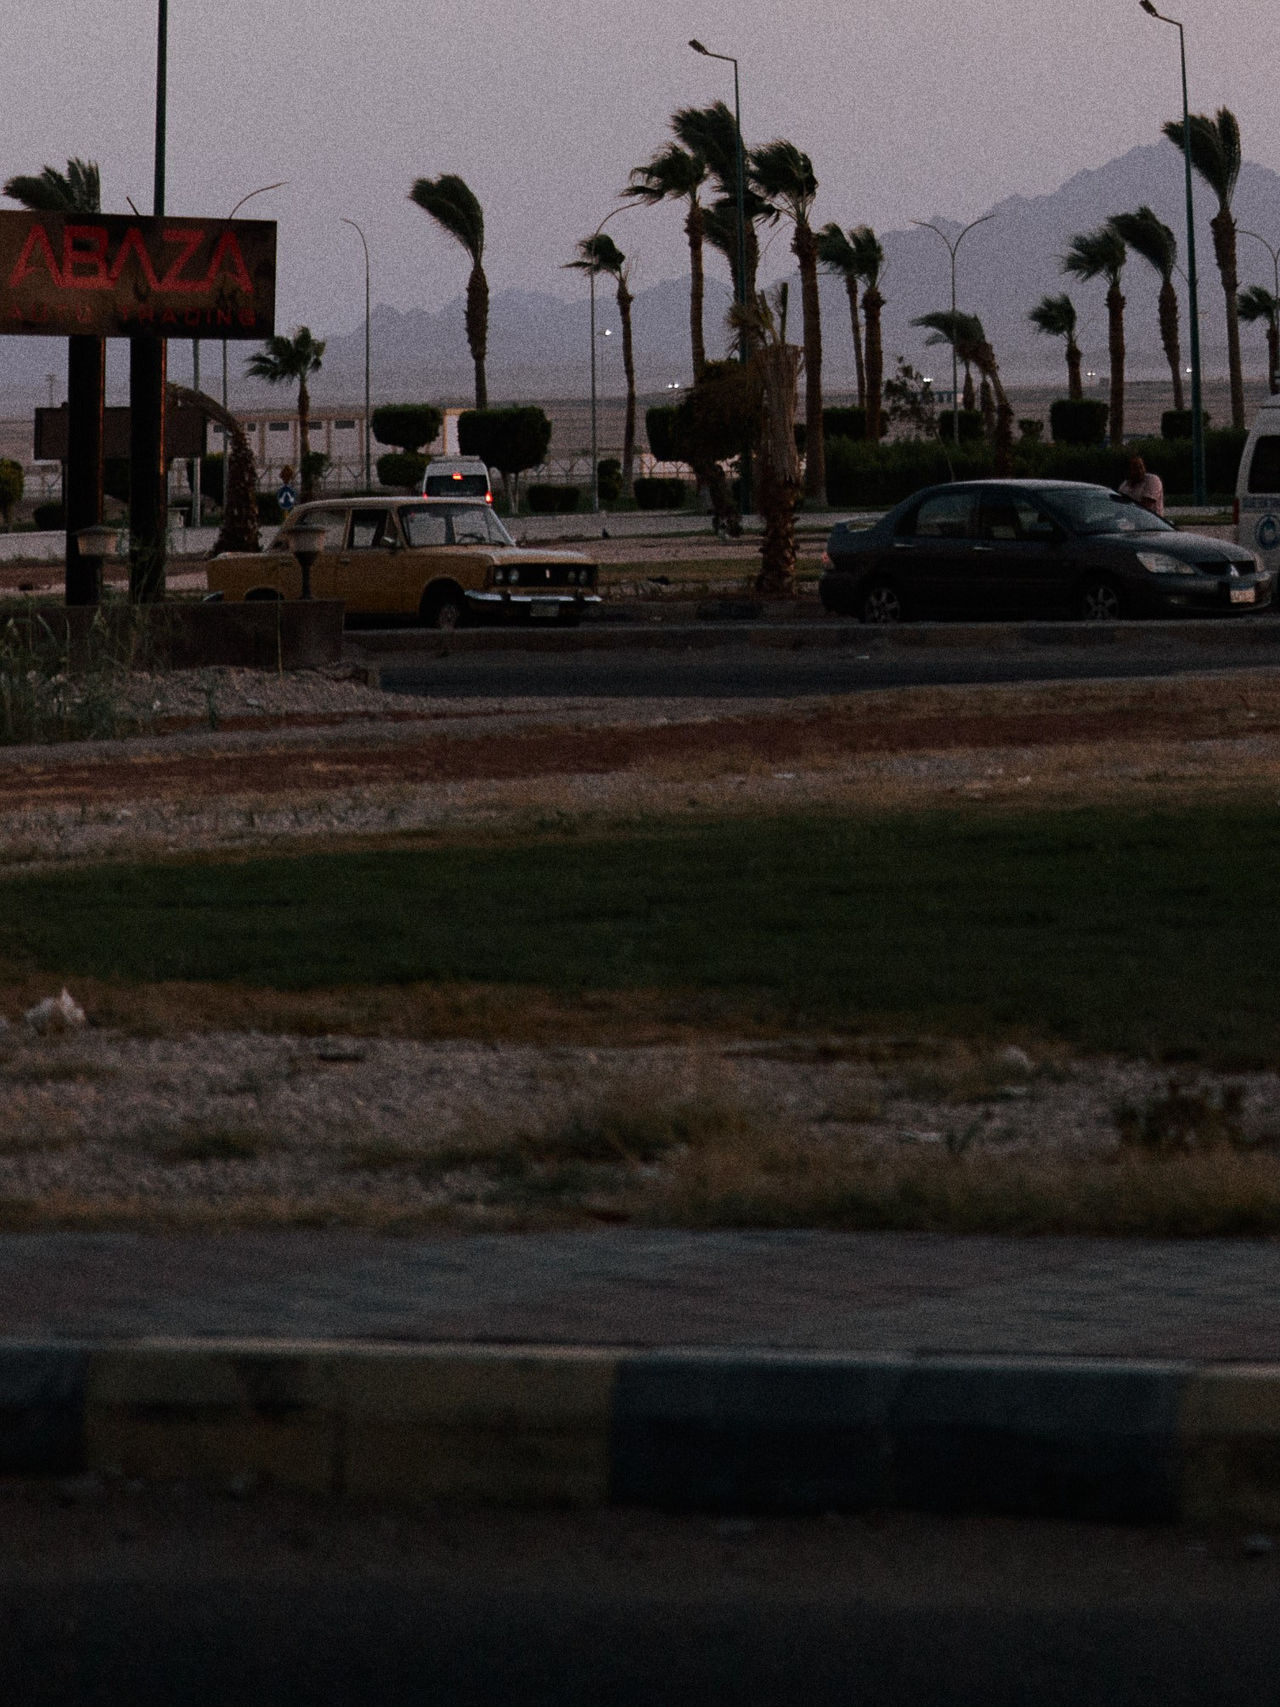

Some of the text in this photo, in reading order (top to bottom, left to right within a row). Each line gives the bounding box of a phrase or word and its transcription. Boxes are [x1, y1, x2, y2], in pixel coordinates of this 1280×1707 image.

[8, 224, 255, 293] ABAZA
[8, 302, 257, 327] AUTO TRADING
